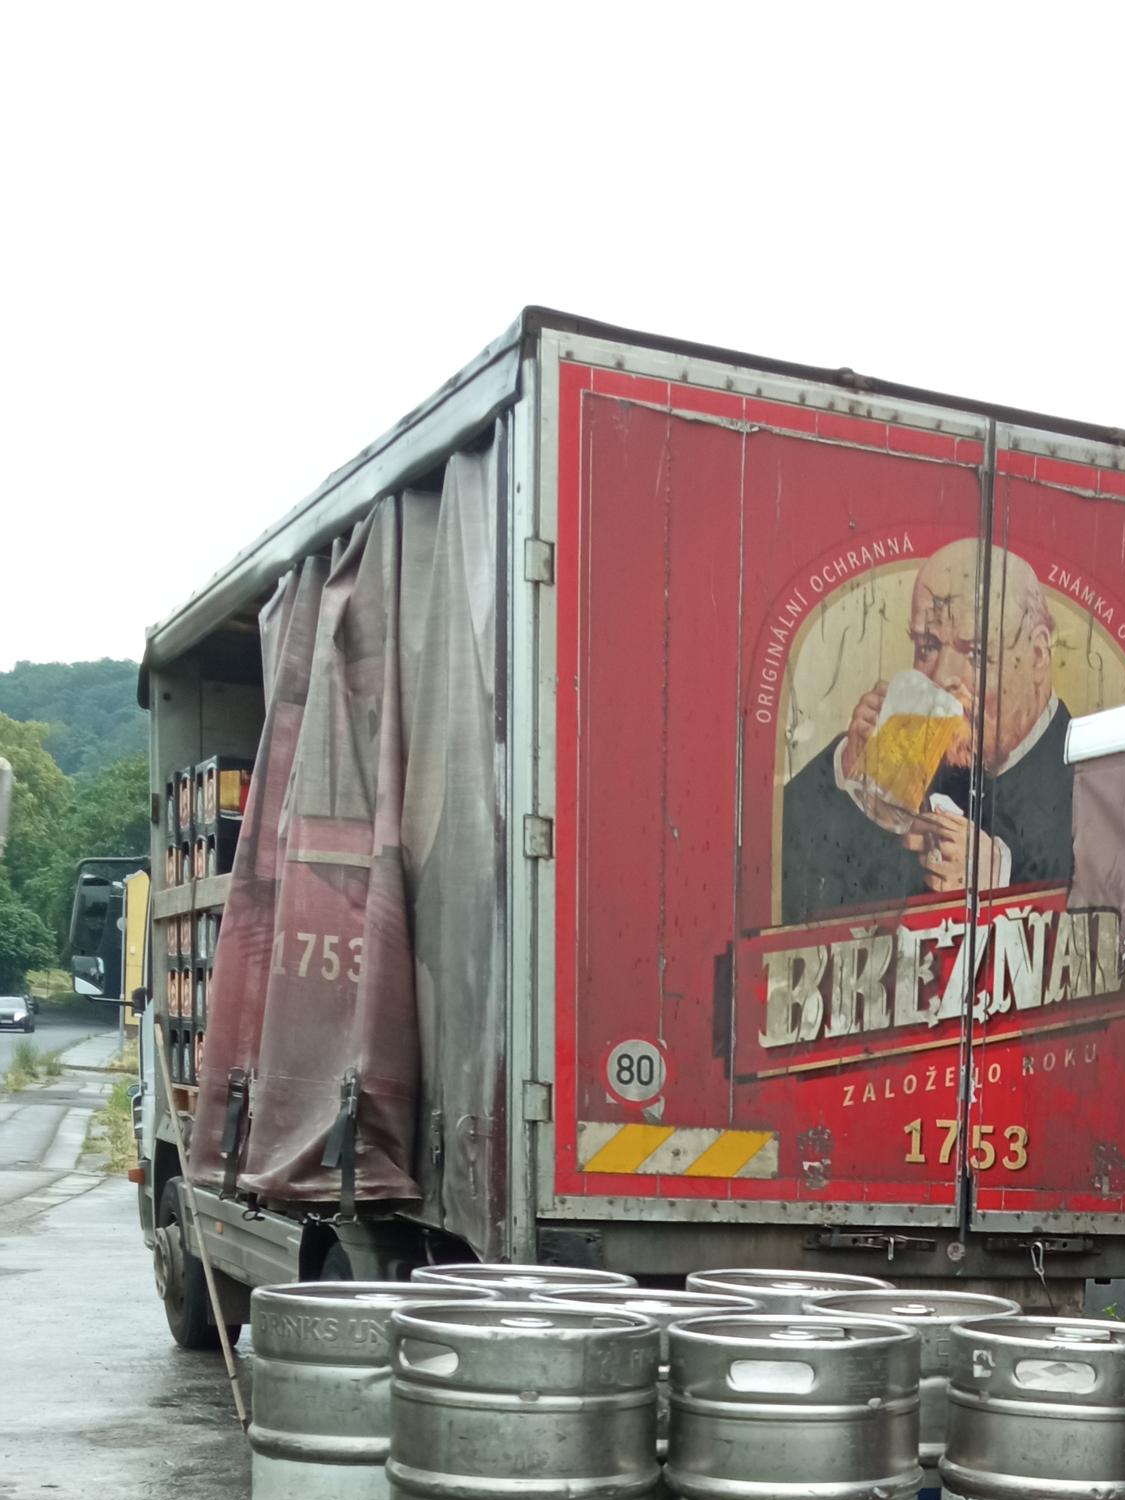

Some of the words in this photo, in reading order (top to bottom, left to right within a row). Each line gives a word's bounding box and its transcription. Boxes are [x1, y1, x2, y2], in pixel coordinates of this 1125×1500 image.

[756, 587, 809, 724] ORIGINÁLNÍ
[808, 532, 915, 593] OCHRANNÁ
[1047, 563, 1115, 624] ZNÁMKA
[271, 930, 364, 983] 1753
[616, 1053, 654, 1087] 80
[904, 1118, 1029, 1171] 1753
